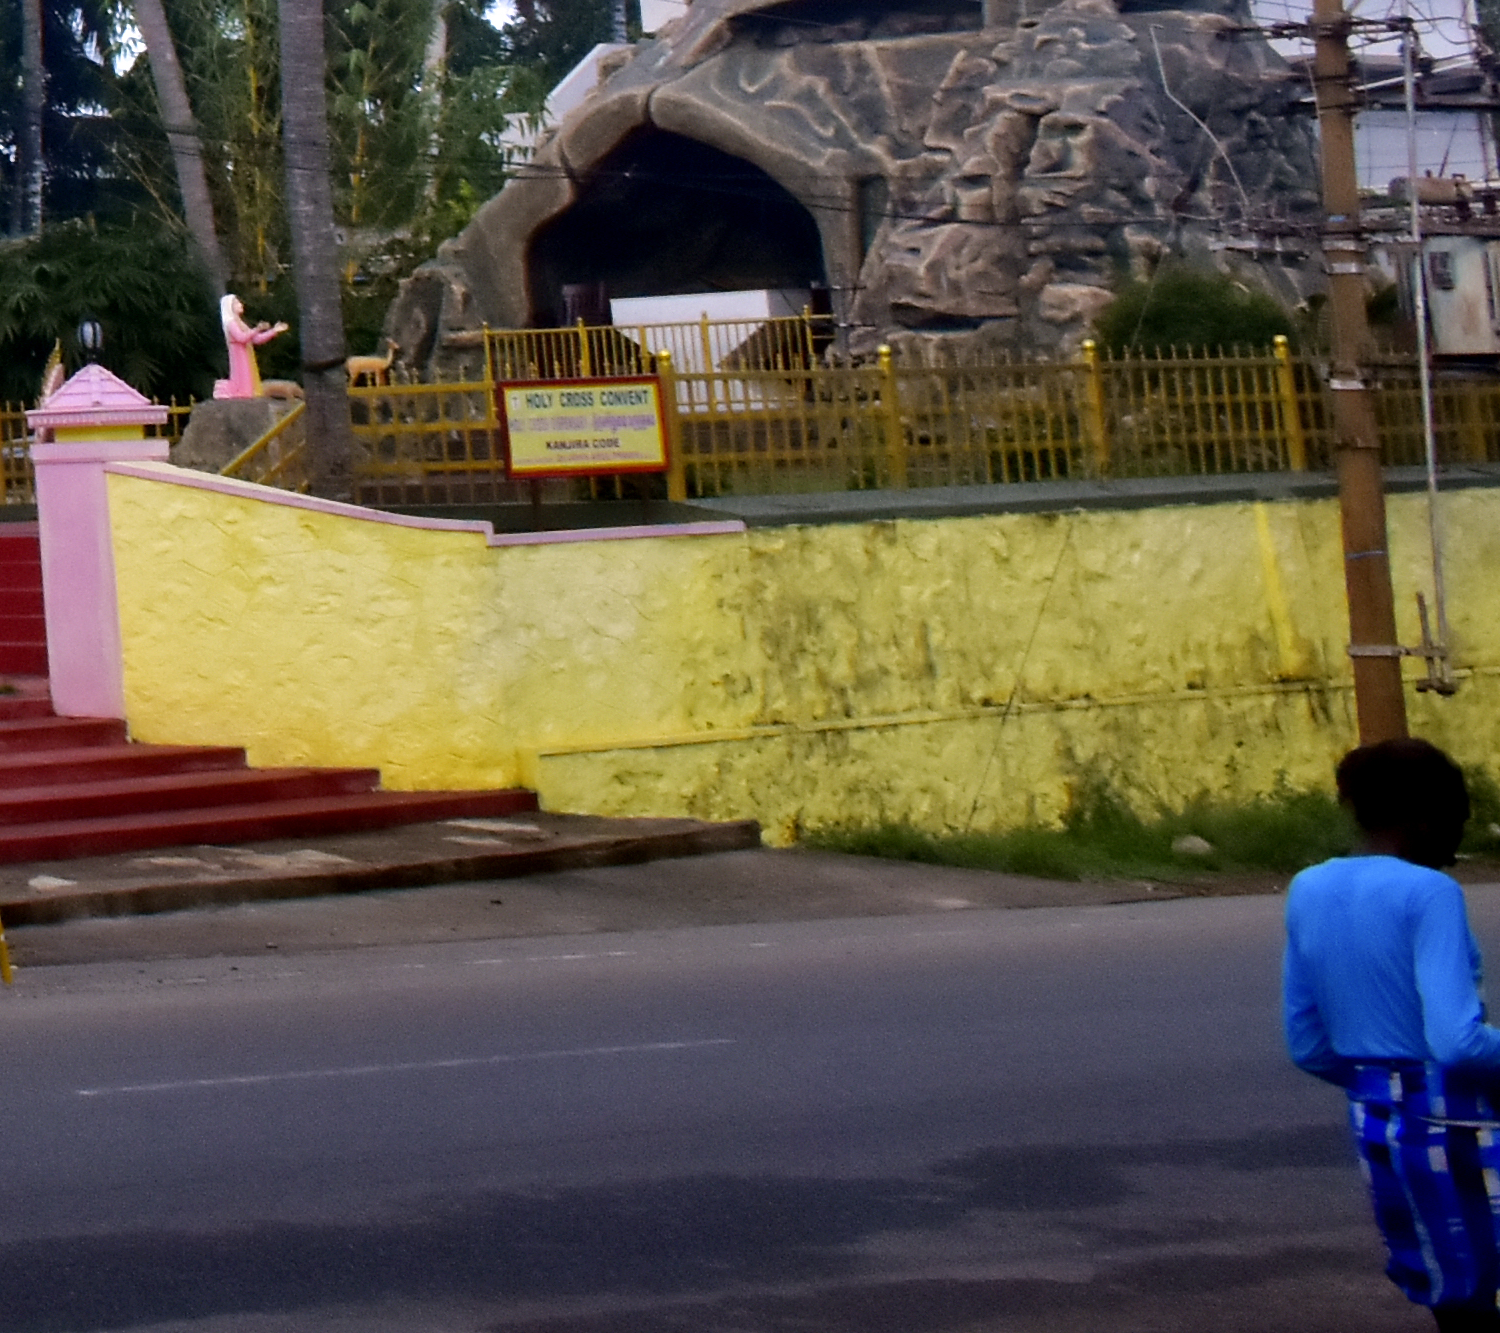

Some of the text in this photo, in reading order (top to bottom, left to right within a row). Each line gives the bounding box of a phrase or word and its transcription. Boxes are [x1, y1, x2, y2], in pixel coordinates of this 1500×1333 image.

[526, 390, 648, 409] HOLY CROSS CONVENT
